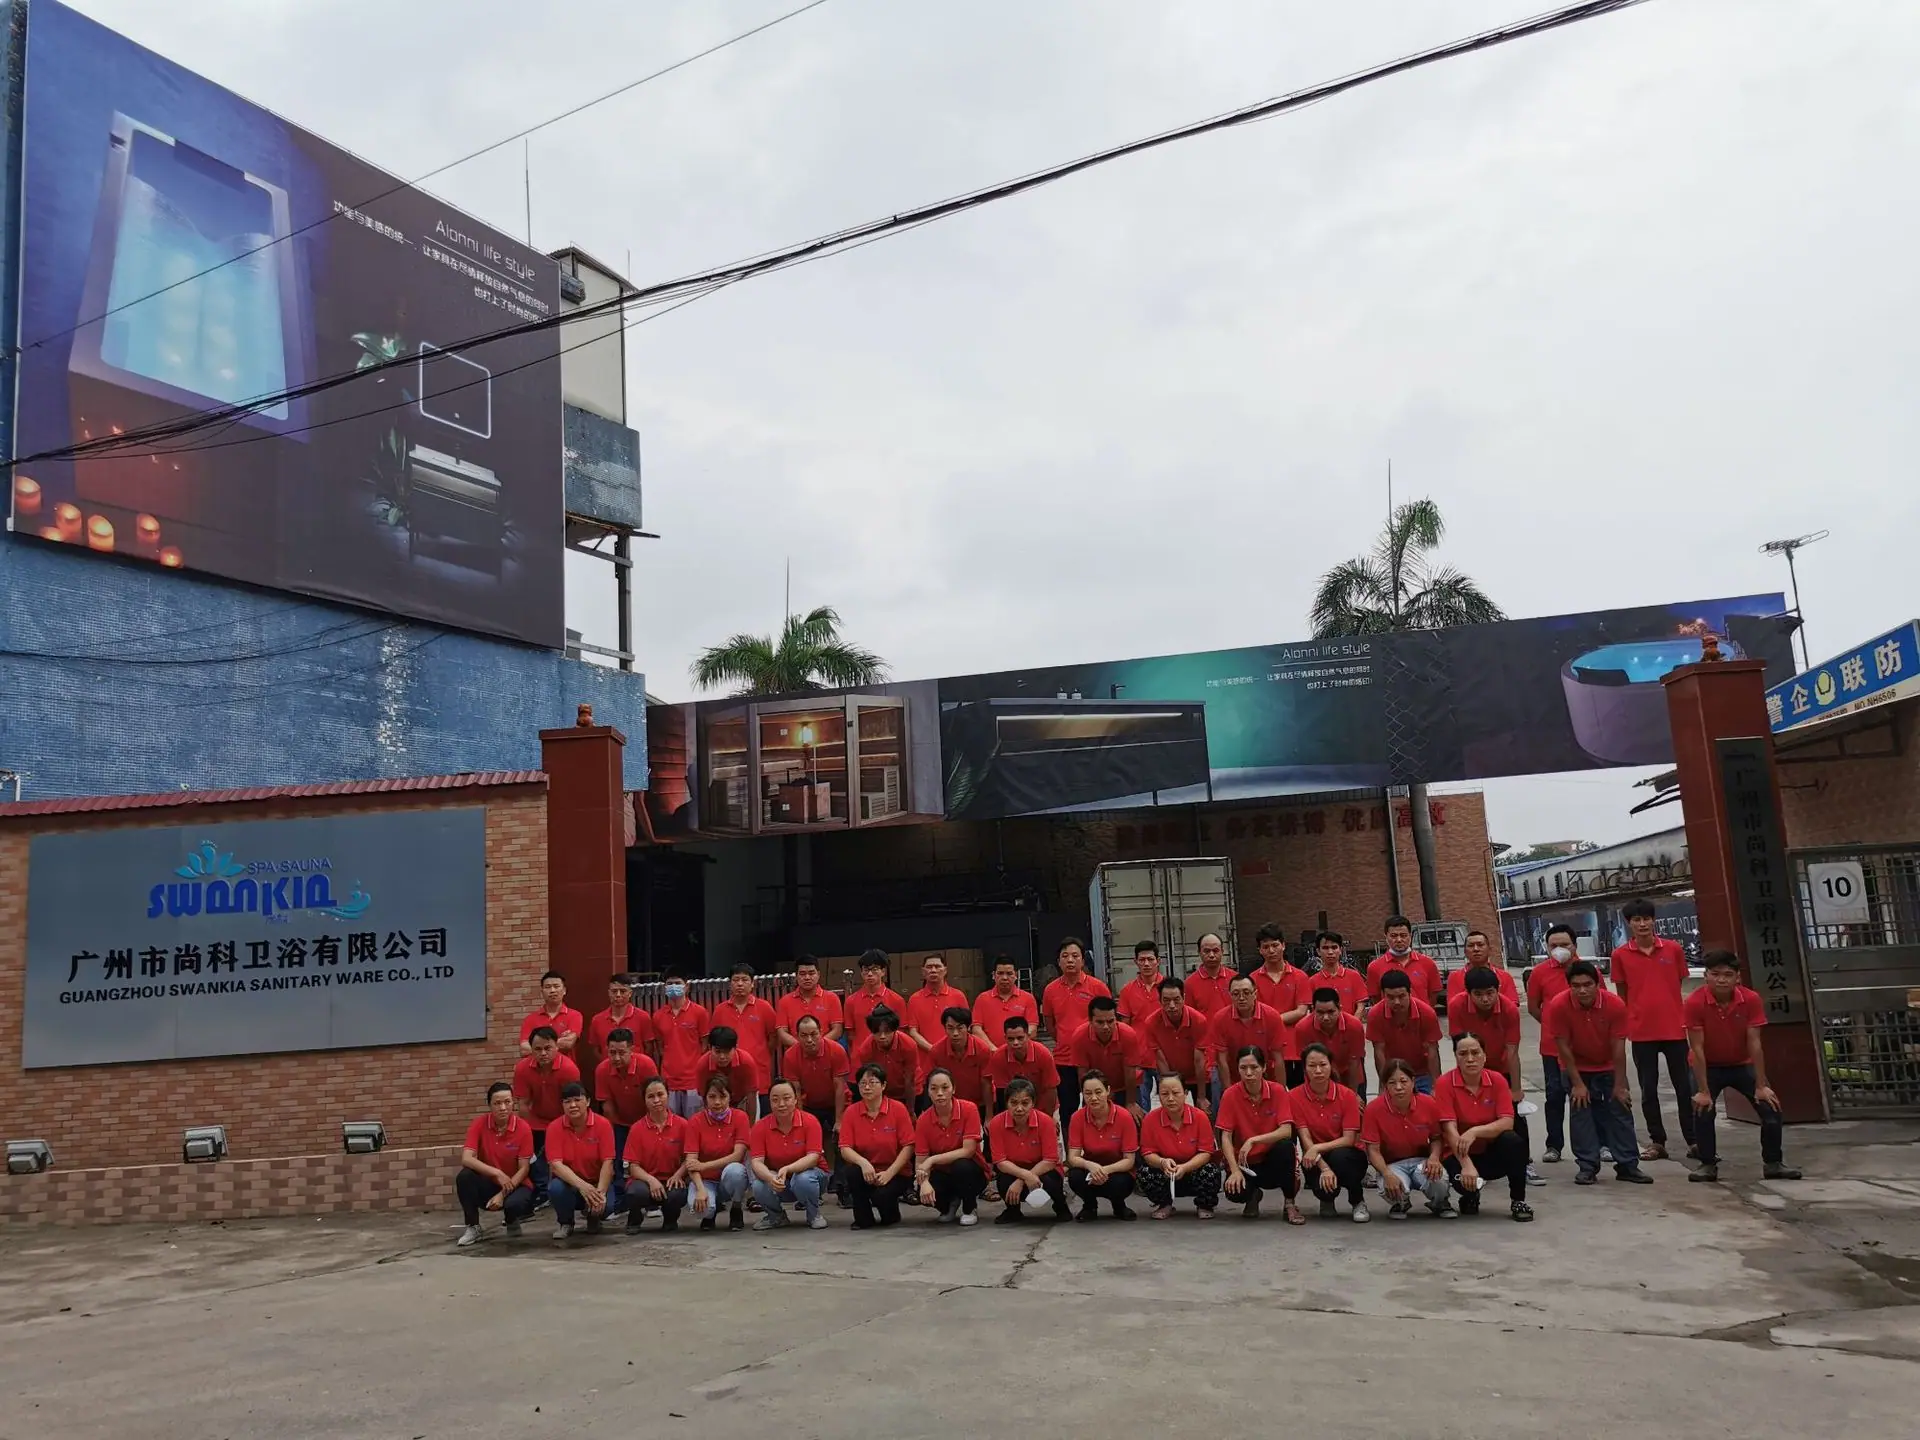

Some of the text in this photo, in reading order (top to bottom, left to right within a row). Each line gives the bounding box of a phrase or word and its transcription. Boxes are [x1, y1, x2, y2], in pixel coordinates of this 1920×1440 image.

[435, 219, 536, 282] Alonni life style
[1281, 642, 1371, 660] Alonni life style
[1822, 876, 1852, 898] 10
[66, 927, 449, 984] 广州市尚科卫浴有限公司
[59, 982, 165, 1005] GUANGZHOU
[168, 978, 247, 998] SWANKIA
[249, 973, 332, 993] SANITARY
[336, 968, 384, 987] WARE
[424, 963, 455, 980] LTD
